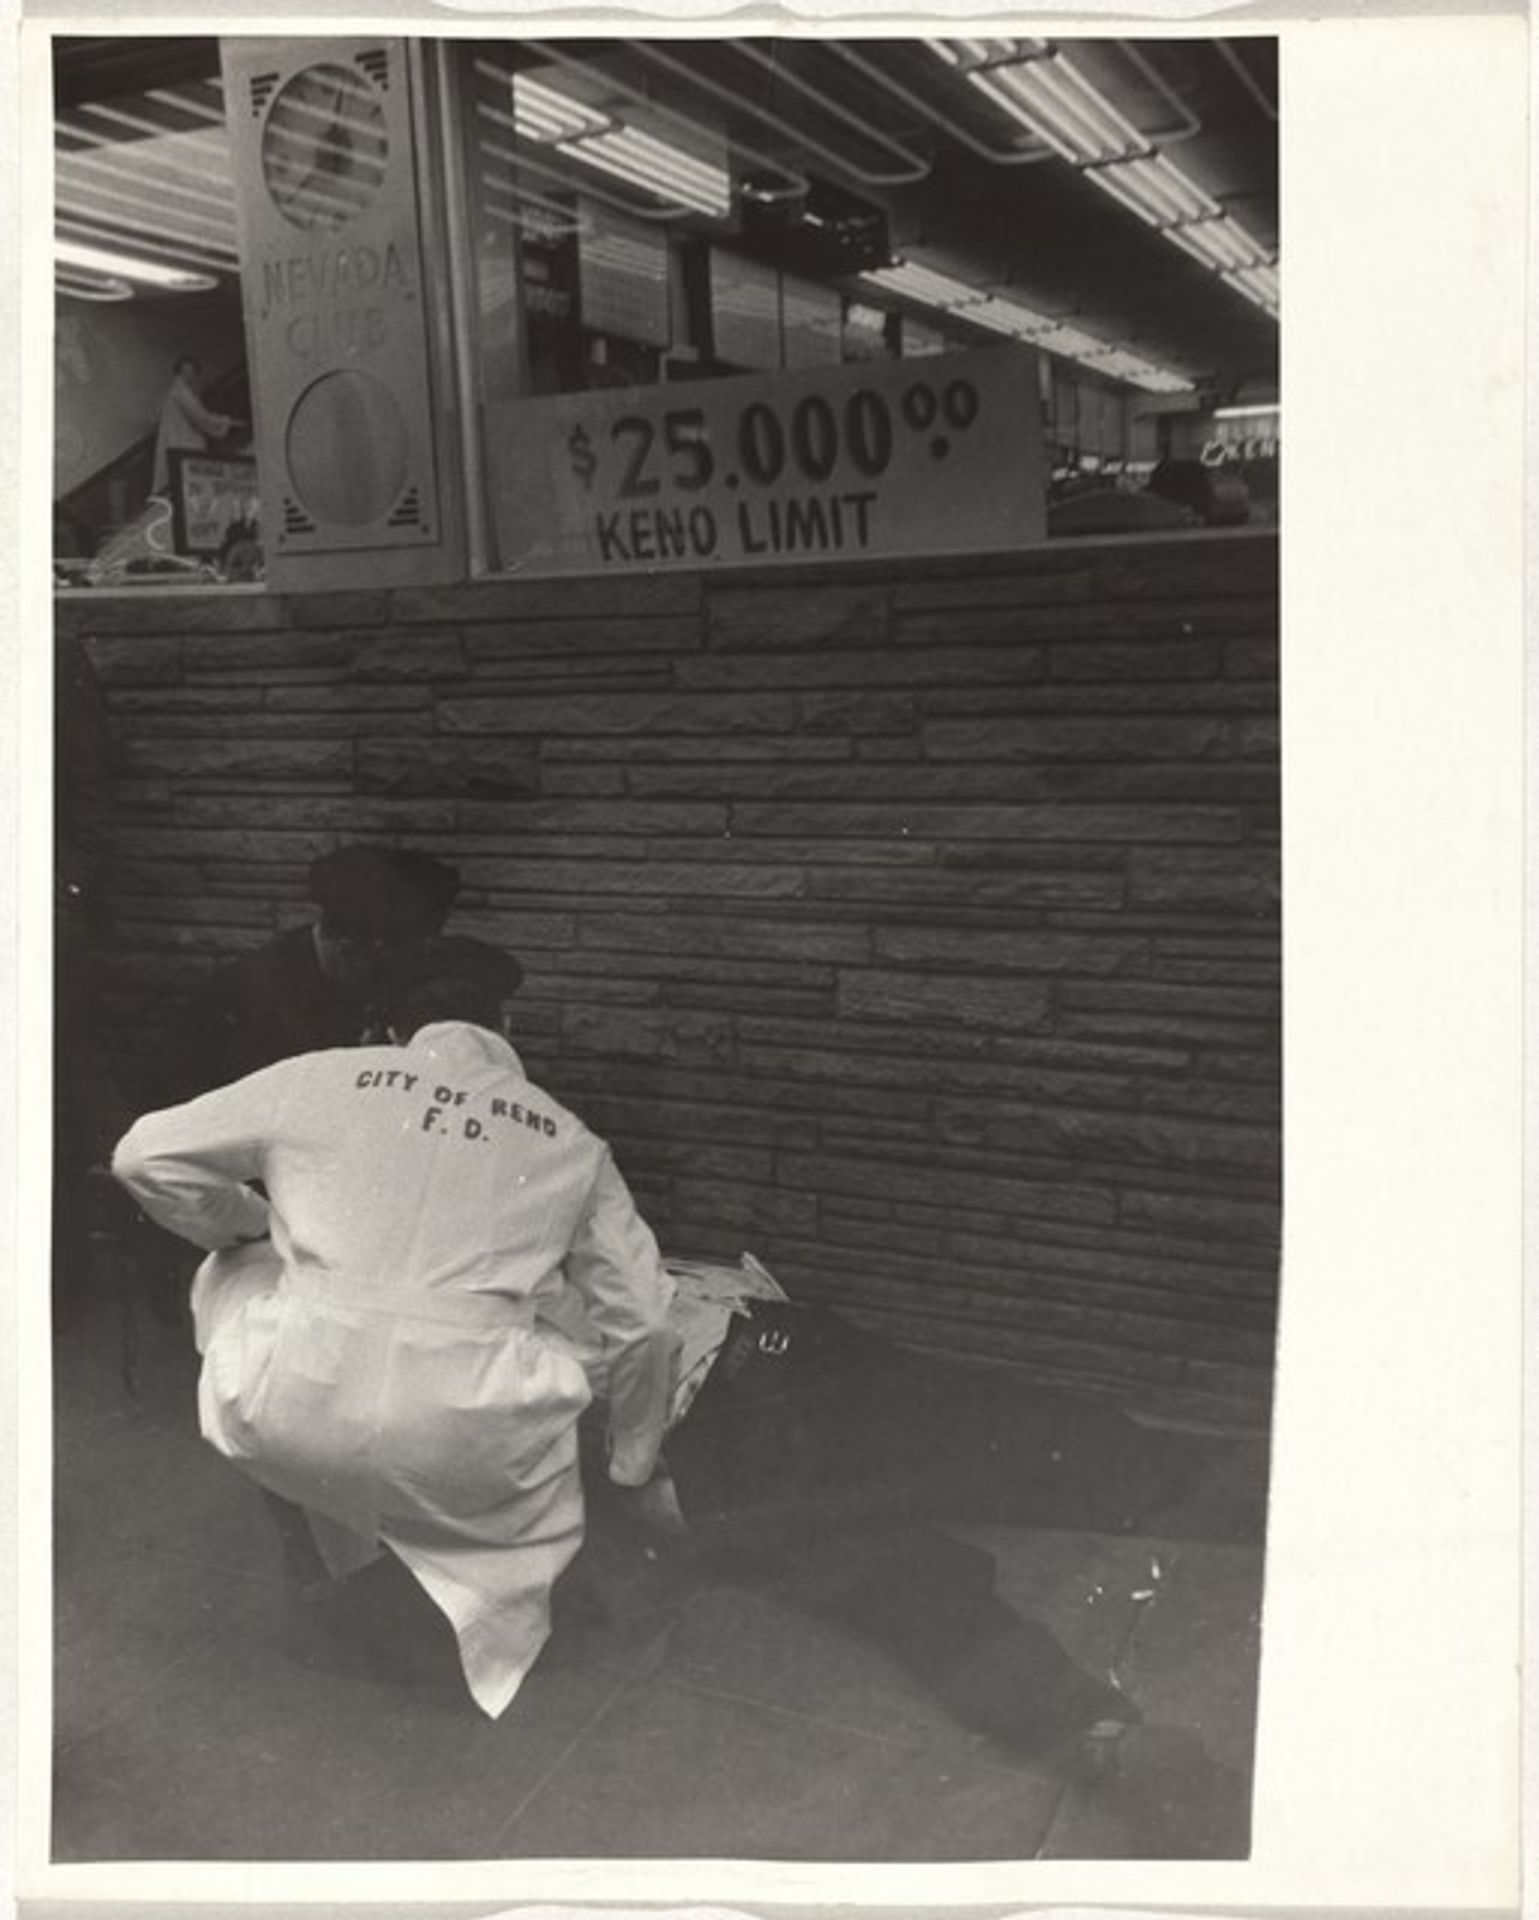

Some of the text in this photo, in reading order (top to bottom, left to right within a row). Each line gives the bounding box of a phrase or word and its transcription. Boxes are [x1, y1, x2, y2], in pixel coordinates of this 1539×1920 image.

[264, 243, 405, 303] NEVADA
[286, 307, 385, 360] CLUB
[598, 493, 877, 561] KENO LIMIT
[356, 1071, 557, 1138] CITY OF RENO
[422, 1107, 490, 1142] F. D.
